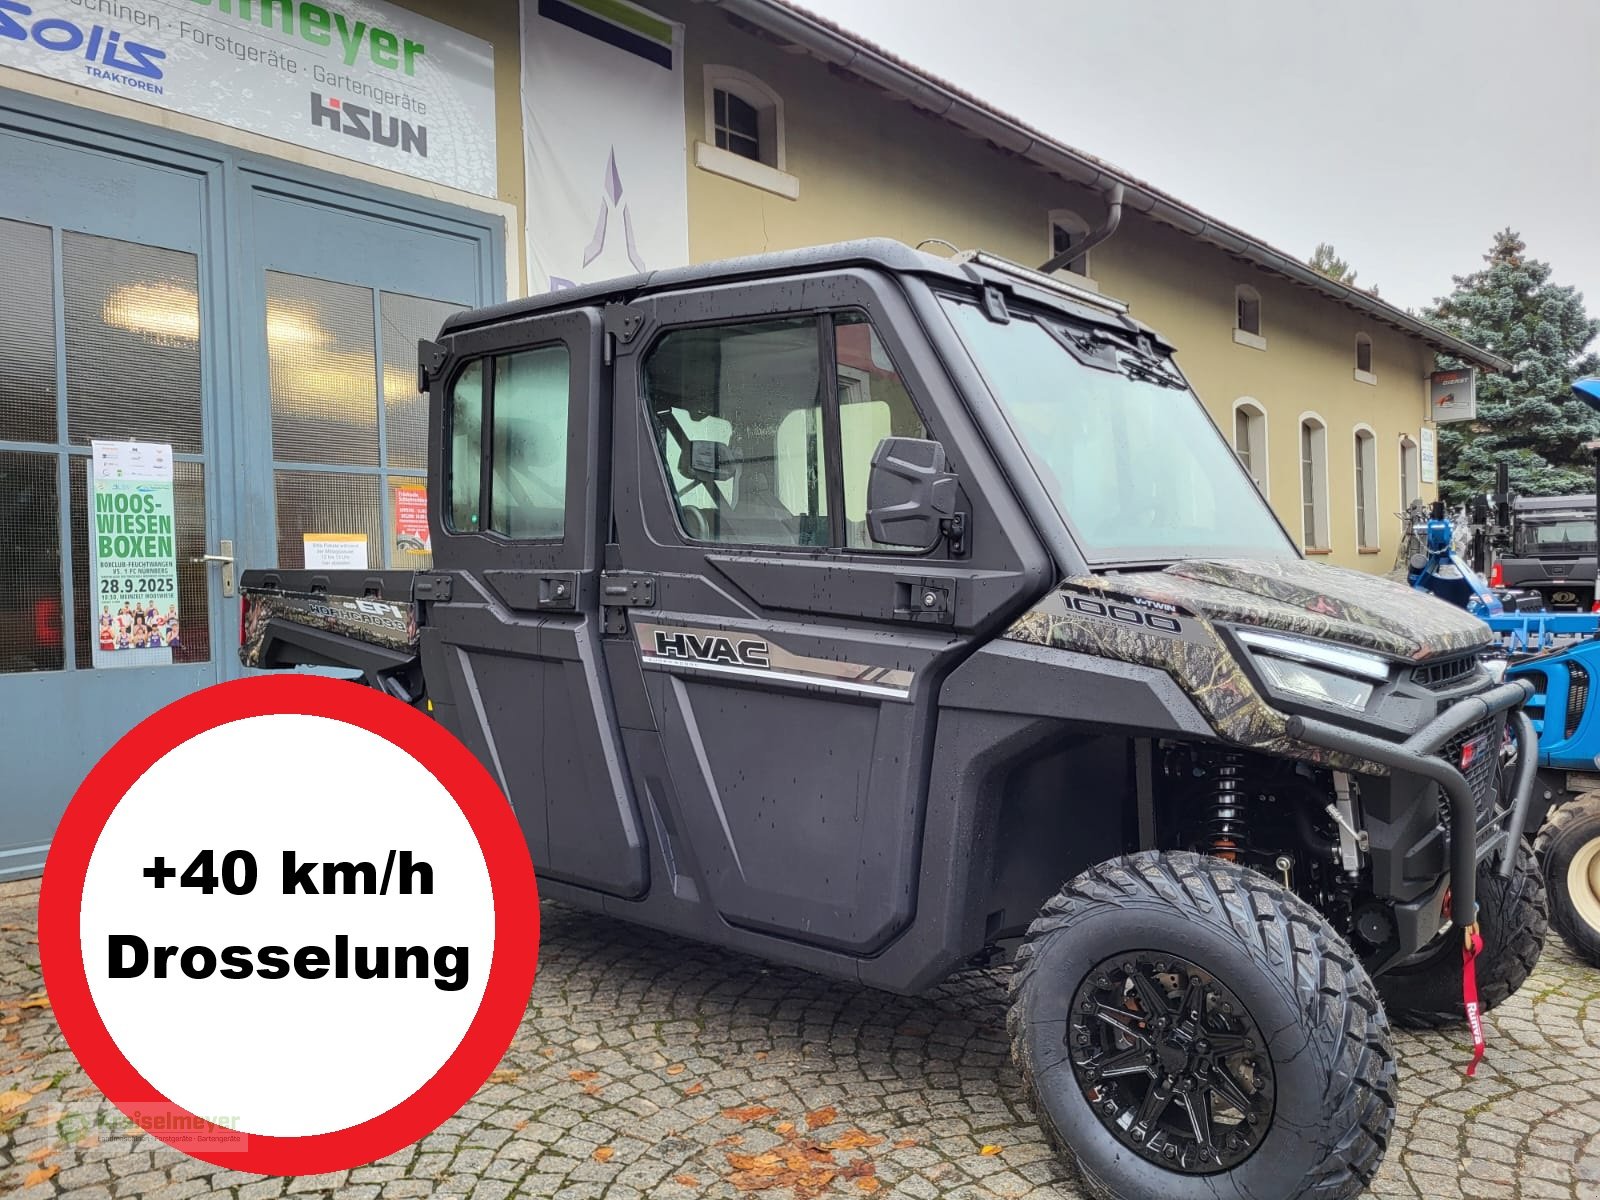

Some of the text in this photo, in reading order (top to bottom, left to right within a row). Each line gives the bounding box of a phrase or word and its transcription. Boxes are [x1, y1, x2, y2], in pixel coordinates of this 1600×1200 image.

[180, 20, 298, 74] Forstgeräte
[313, 65, 427, 115] Gartengeräte
[85, 65, 163, 95] TRAKTOREN
[96, 493, 162, 514] MOOS-
[96, 514, 171, 534] WIESEN
[98, 535, 173, 558] BOXEN
[101, 578, 174, 594] 28.9.2025
[1059, 593, 1183, 634] 1000
[1133, 596, 1176, 612] V-TWIN
[653, 630, 770, 668] HVAC
